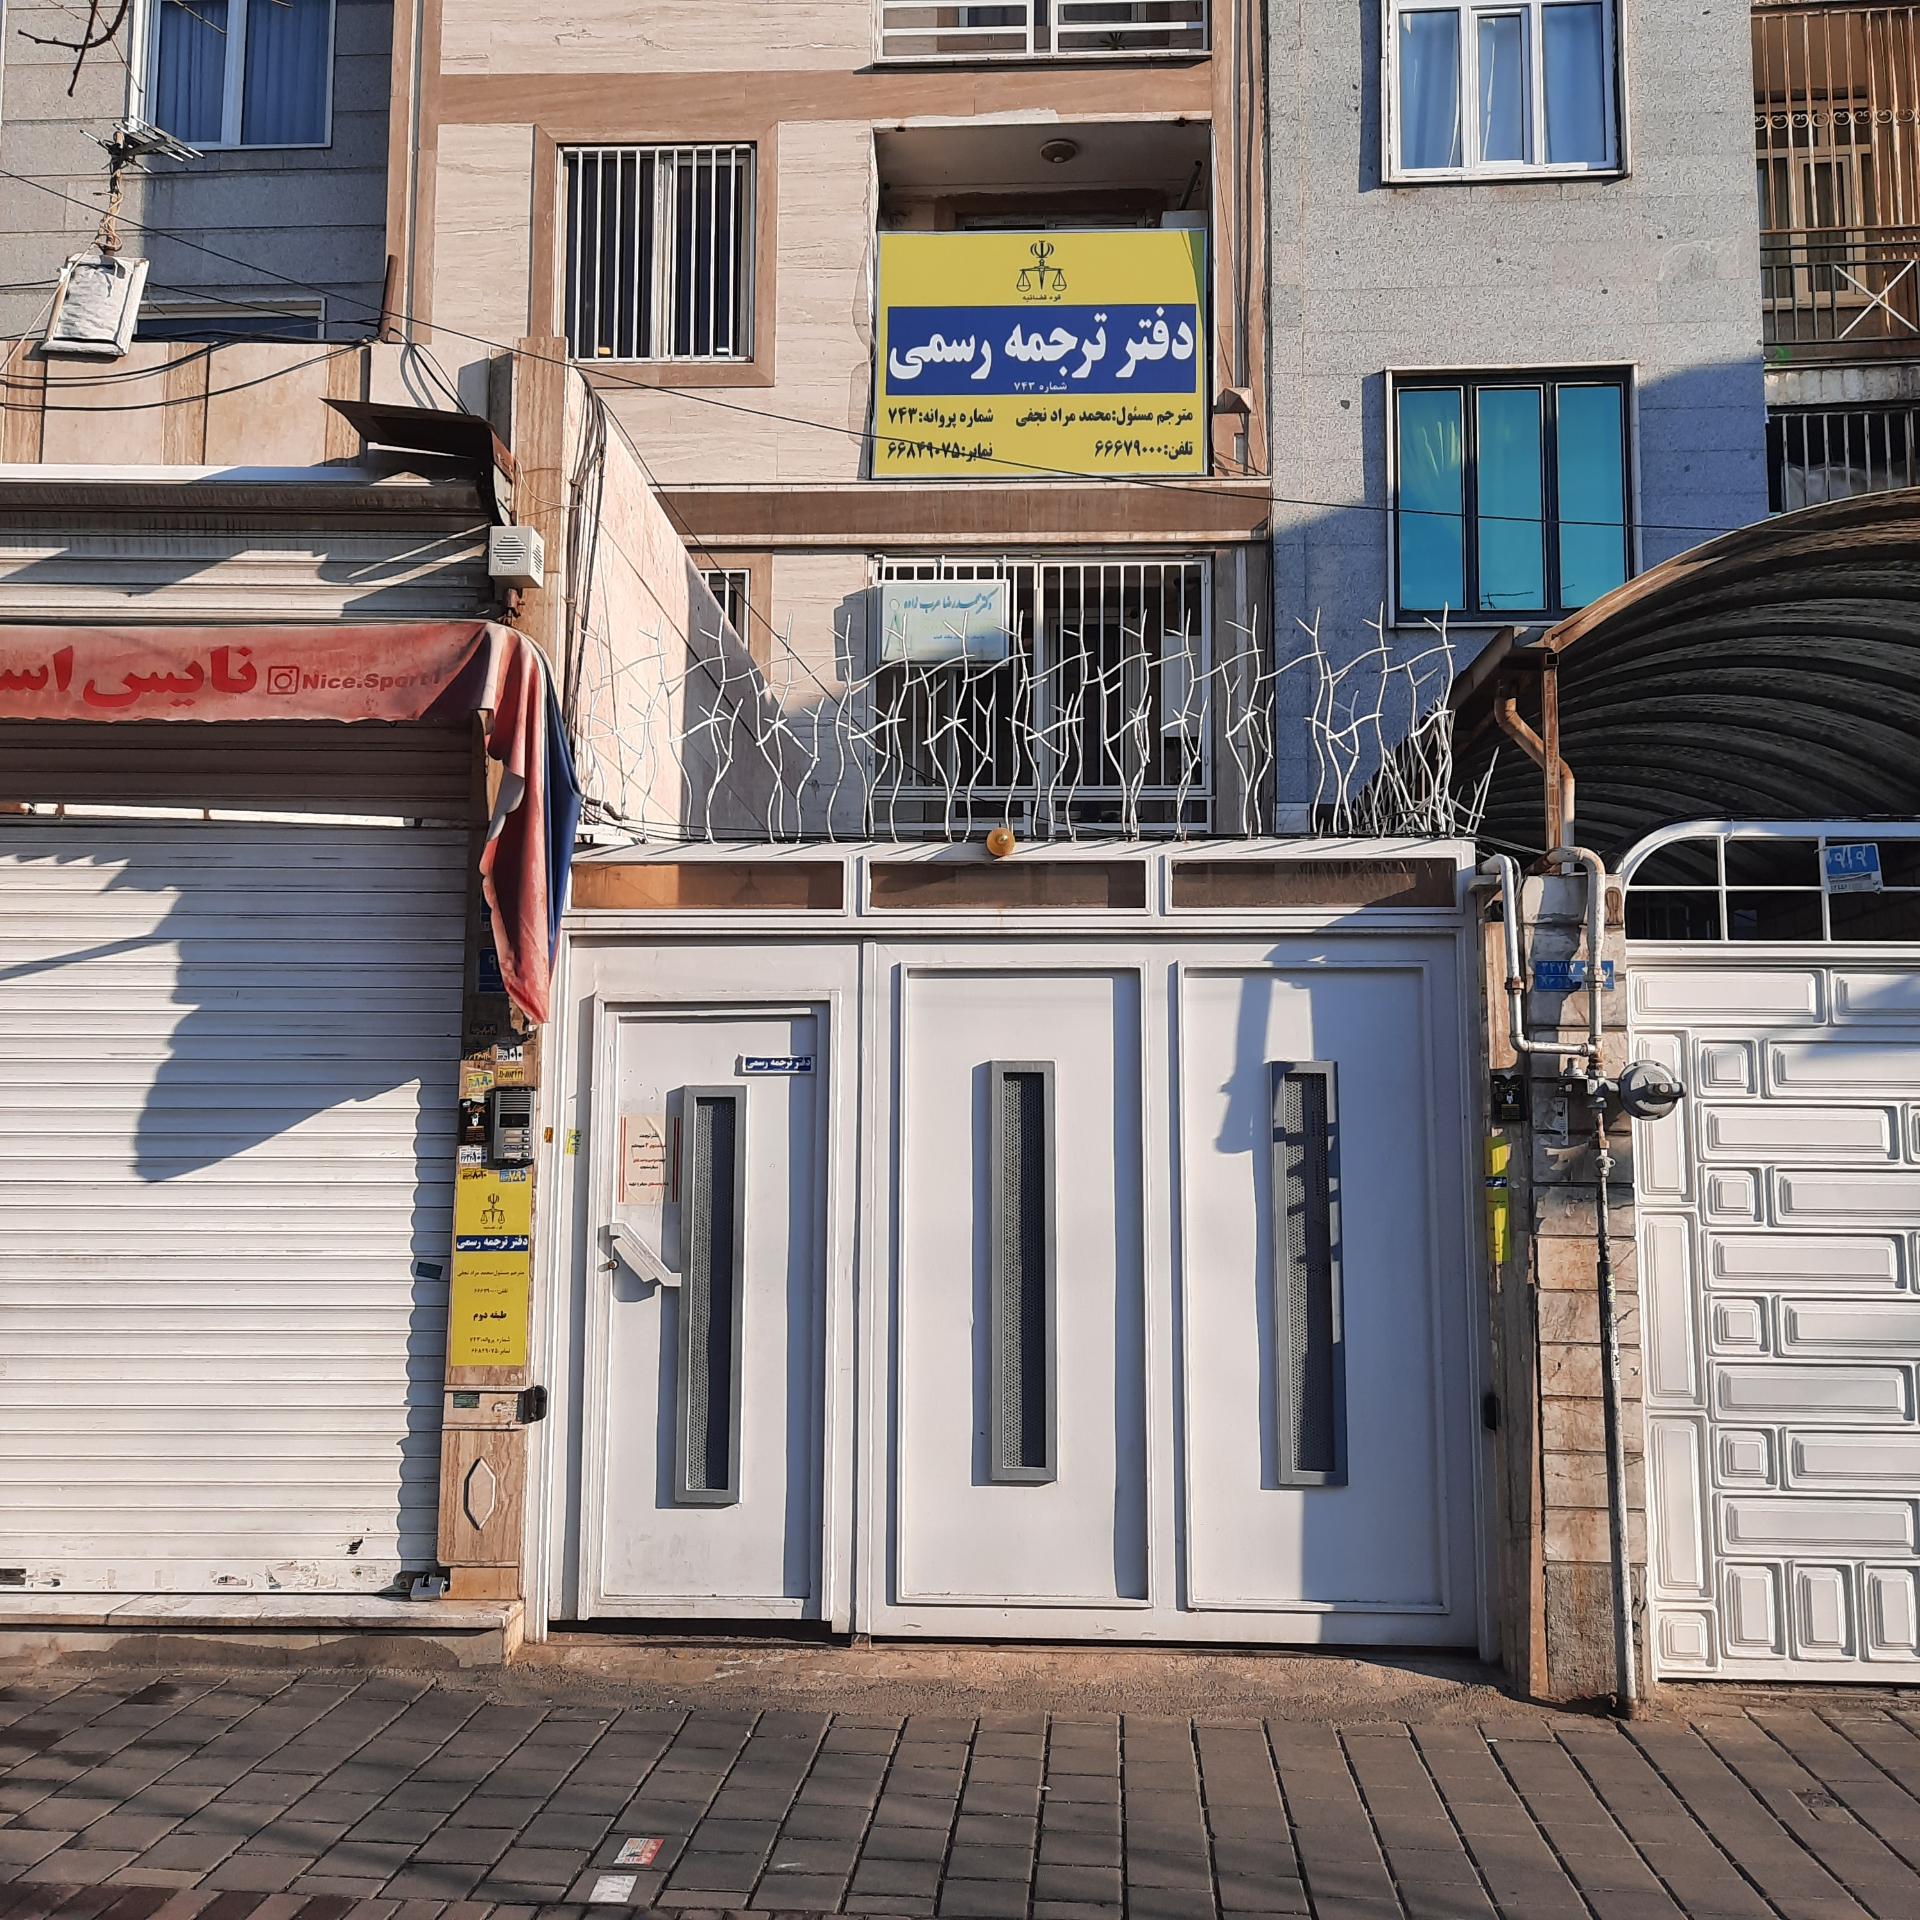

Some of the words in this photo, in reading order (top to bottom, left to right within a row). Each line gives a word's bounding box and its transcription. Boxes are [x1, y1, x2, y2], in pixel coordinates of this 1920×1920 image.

[1004, 312, 1108, 378] ترجمه
[1115, 306, 1194, 378] دفتر
[889, 332, 992, 380] رسمی
[1039, 381, 1068, 393] شماره
[960, 406, 994, 427] شماره
[1016, 407, 1047, 427] نجفی
[1050, 407, 1076, 427] مراد
[1156, 408, 1193, 426] مترجم
[83, 644, 257, 708] نایس
[456, 1240, 481, 1250] رسمی
[483, 1236, 508, 1249] ترجمه
[510, 1235, 528, 1250] دفتر
[473, 1312, 488, 1321] دوم
[490, 1310, 507, 1321] طبقه
